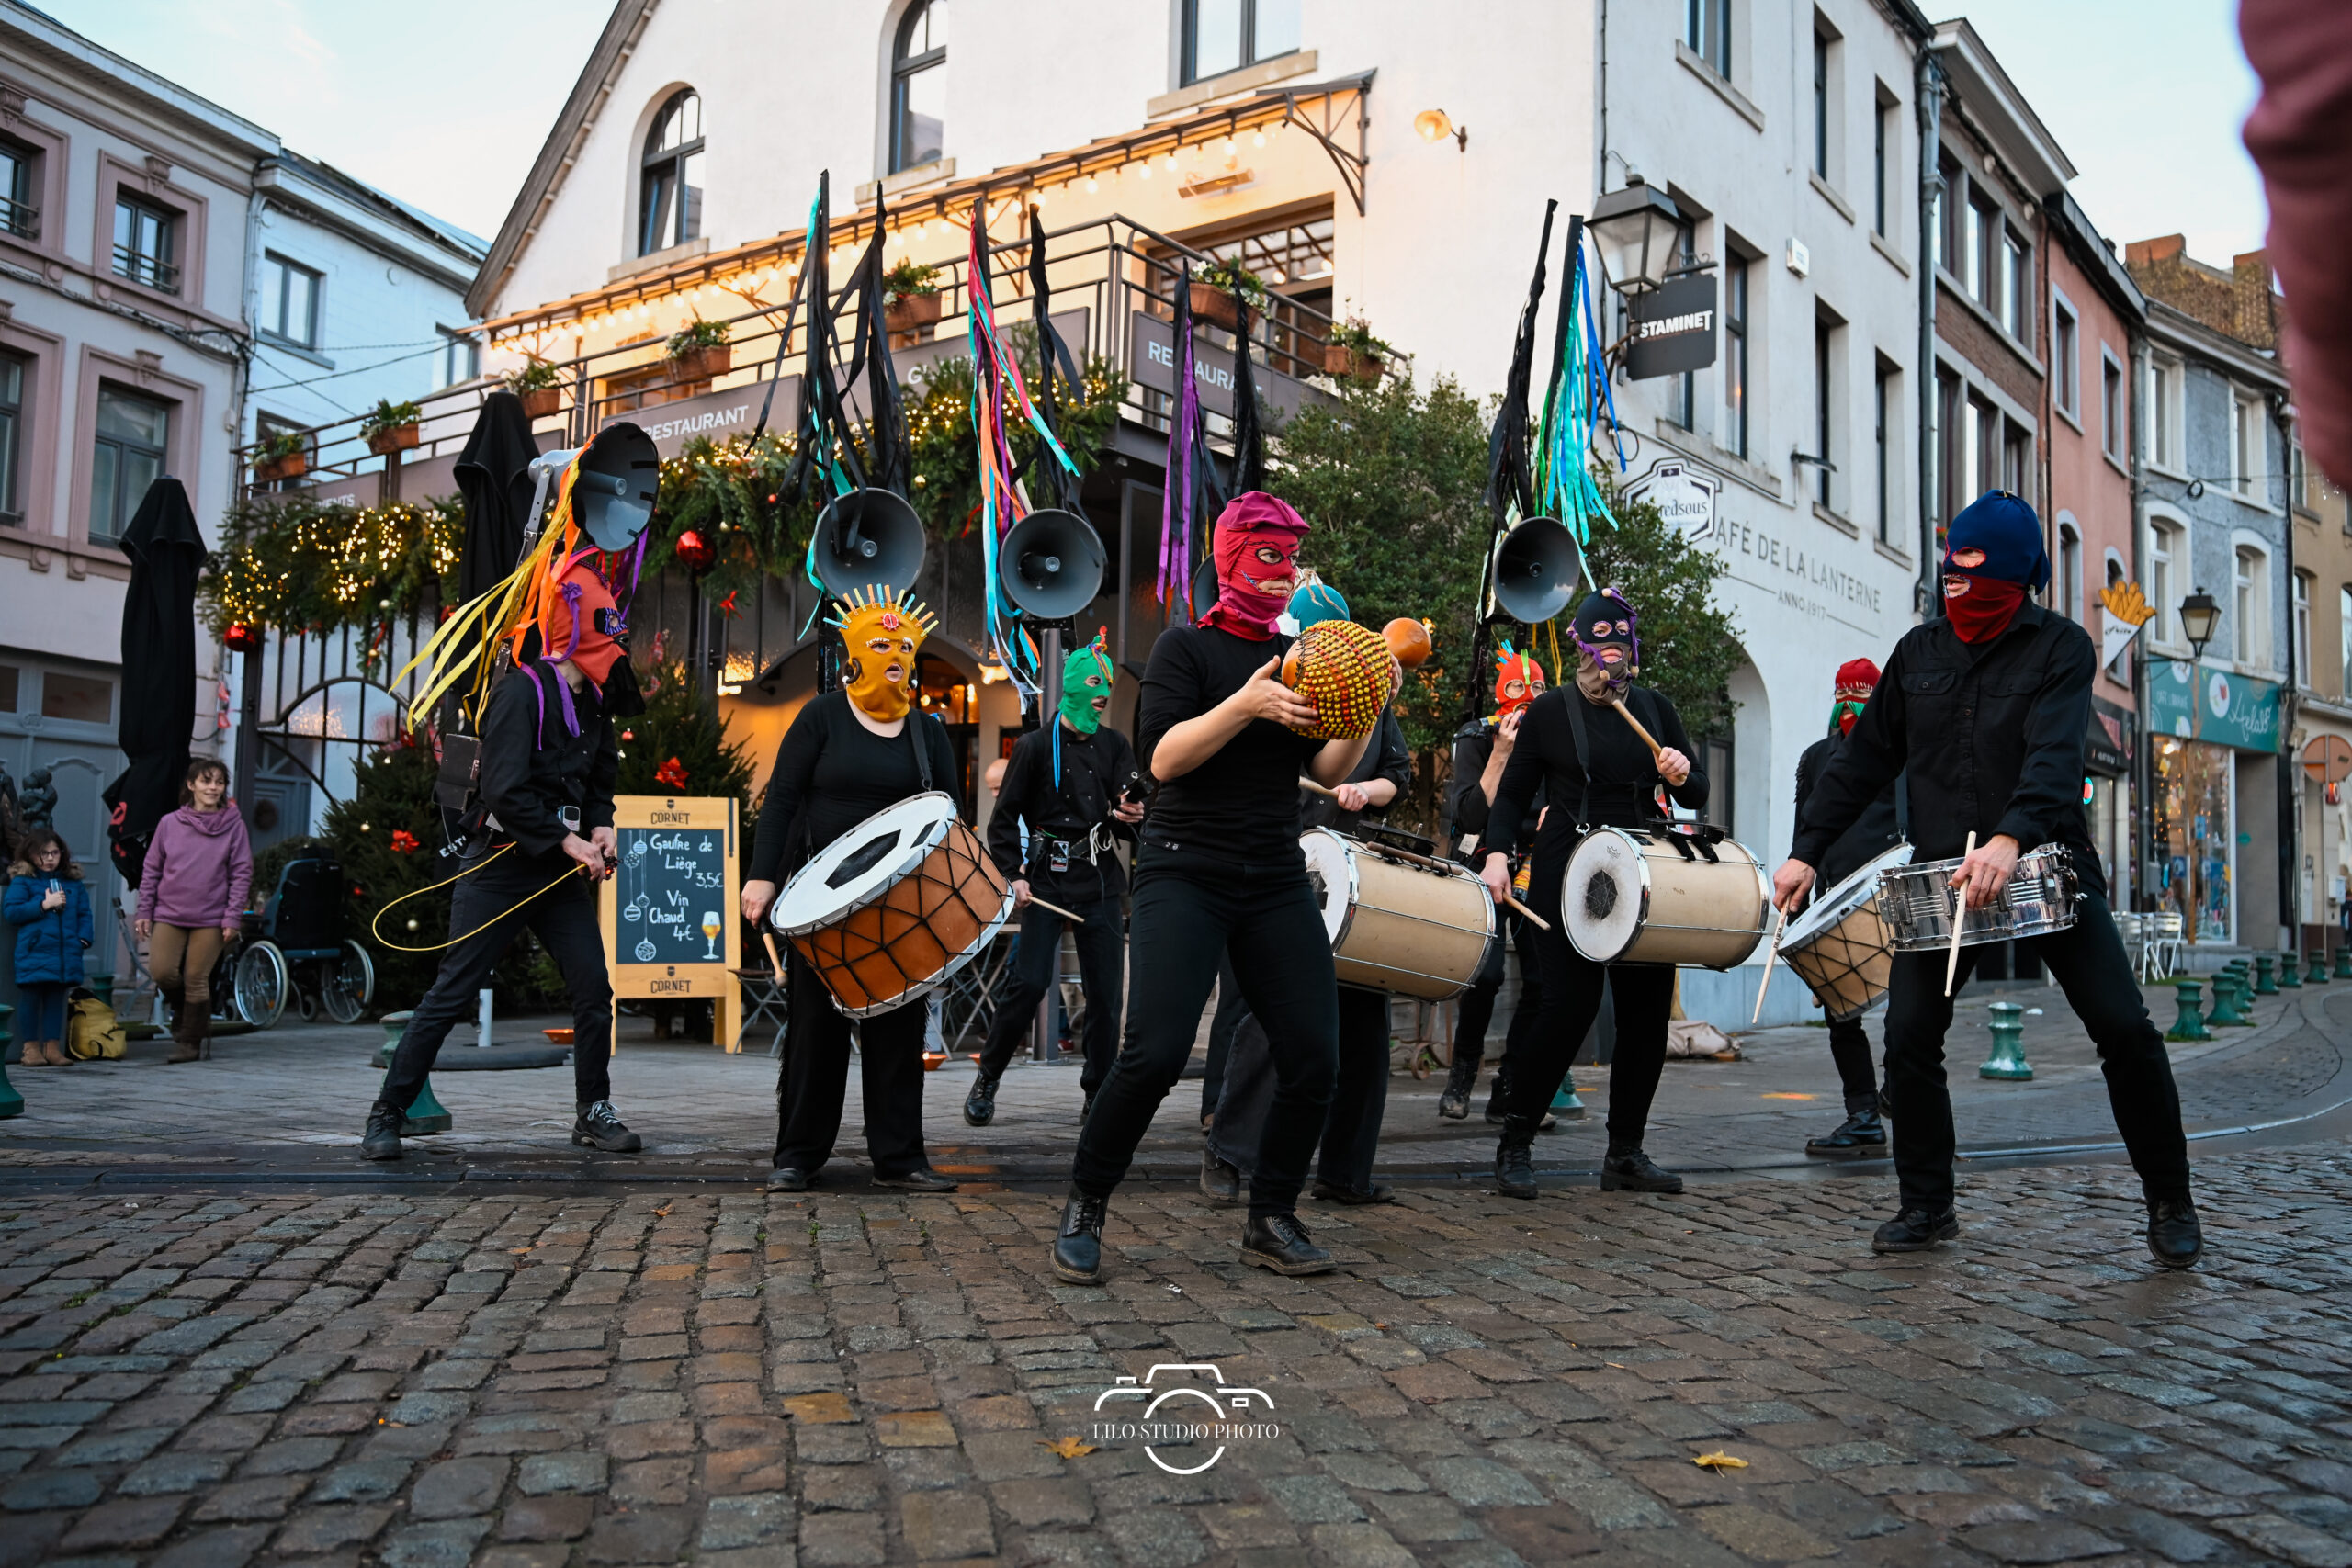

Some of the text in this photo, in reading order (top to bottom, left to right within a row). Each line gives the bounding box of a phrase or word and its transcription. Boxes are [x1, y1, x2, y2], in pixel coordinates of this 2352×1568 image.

[1631, 310, 1713, 344] STAMINET
[1715, 516, 1881, 614] AFÉ DE LA LANTERNE
[1778, 590, 1826, 620] ANNO 1917
[650, 812, 691, 825] CORNET
[650, 833, 713, 855] Gaufre de
[665, 853, 697, 879] Liège
[695, 873, 724, 888] 3,5€
[666, 889, 689, 907] Vin
[649, 907, 685, 924] Chaud
[673, 924, 694, 942] 4€
[650, 980, 691, 994] CORNET
